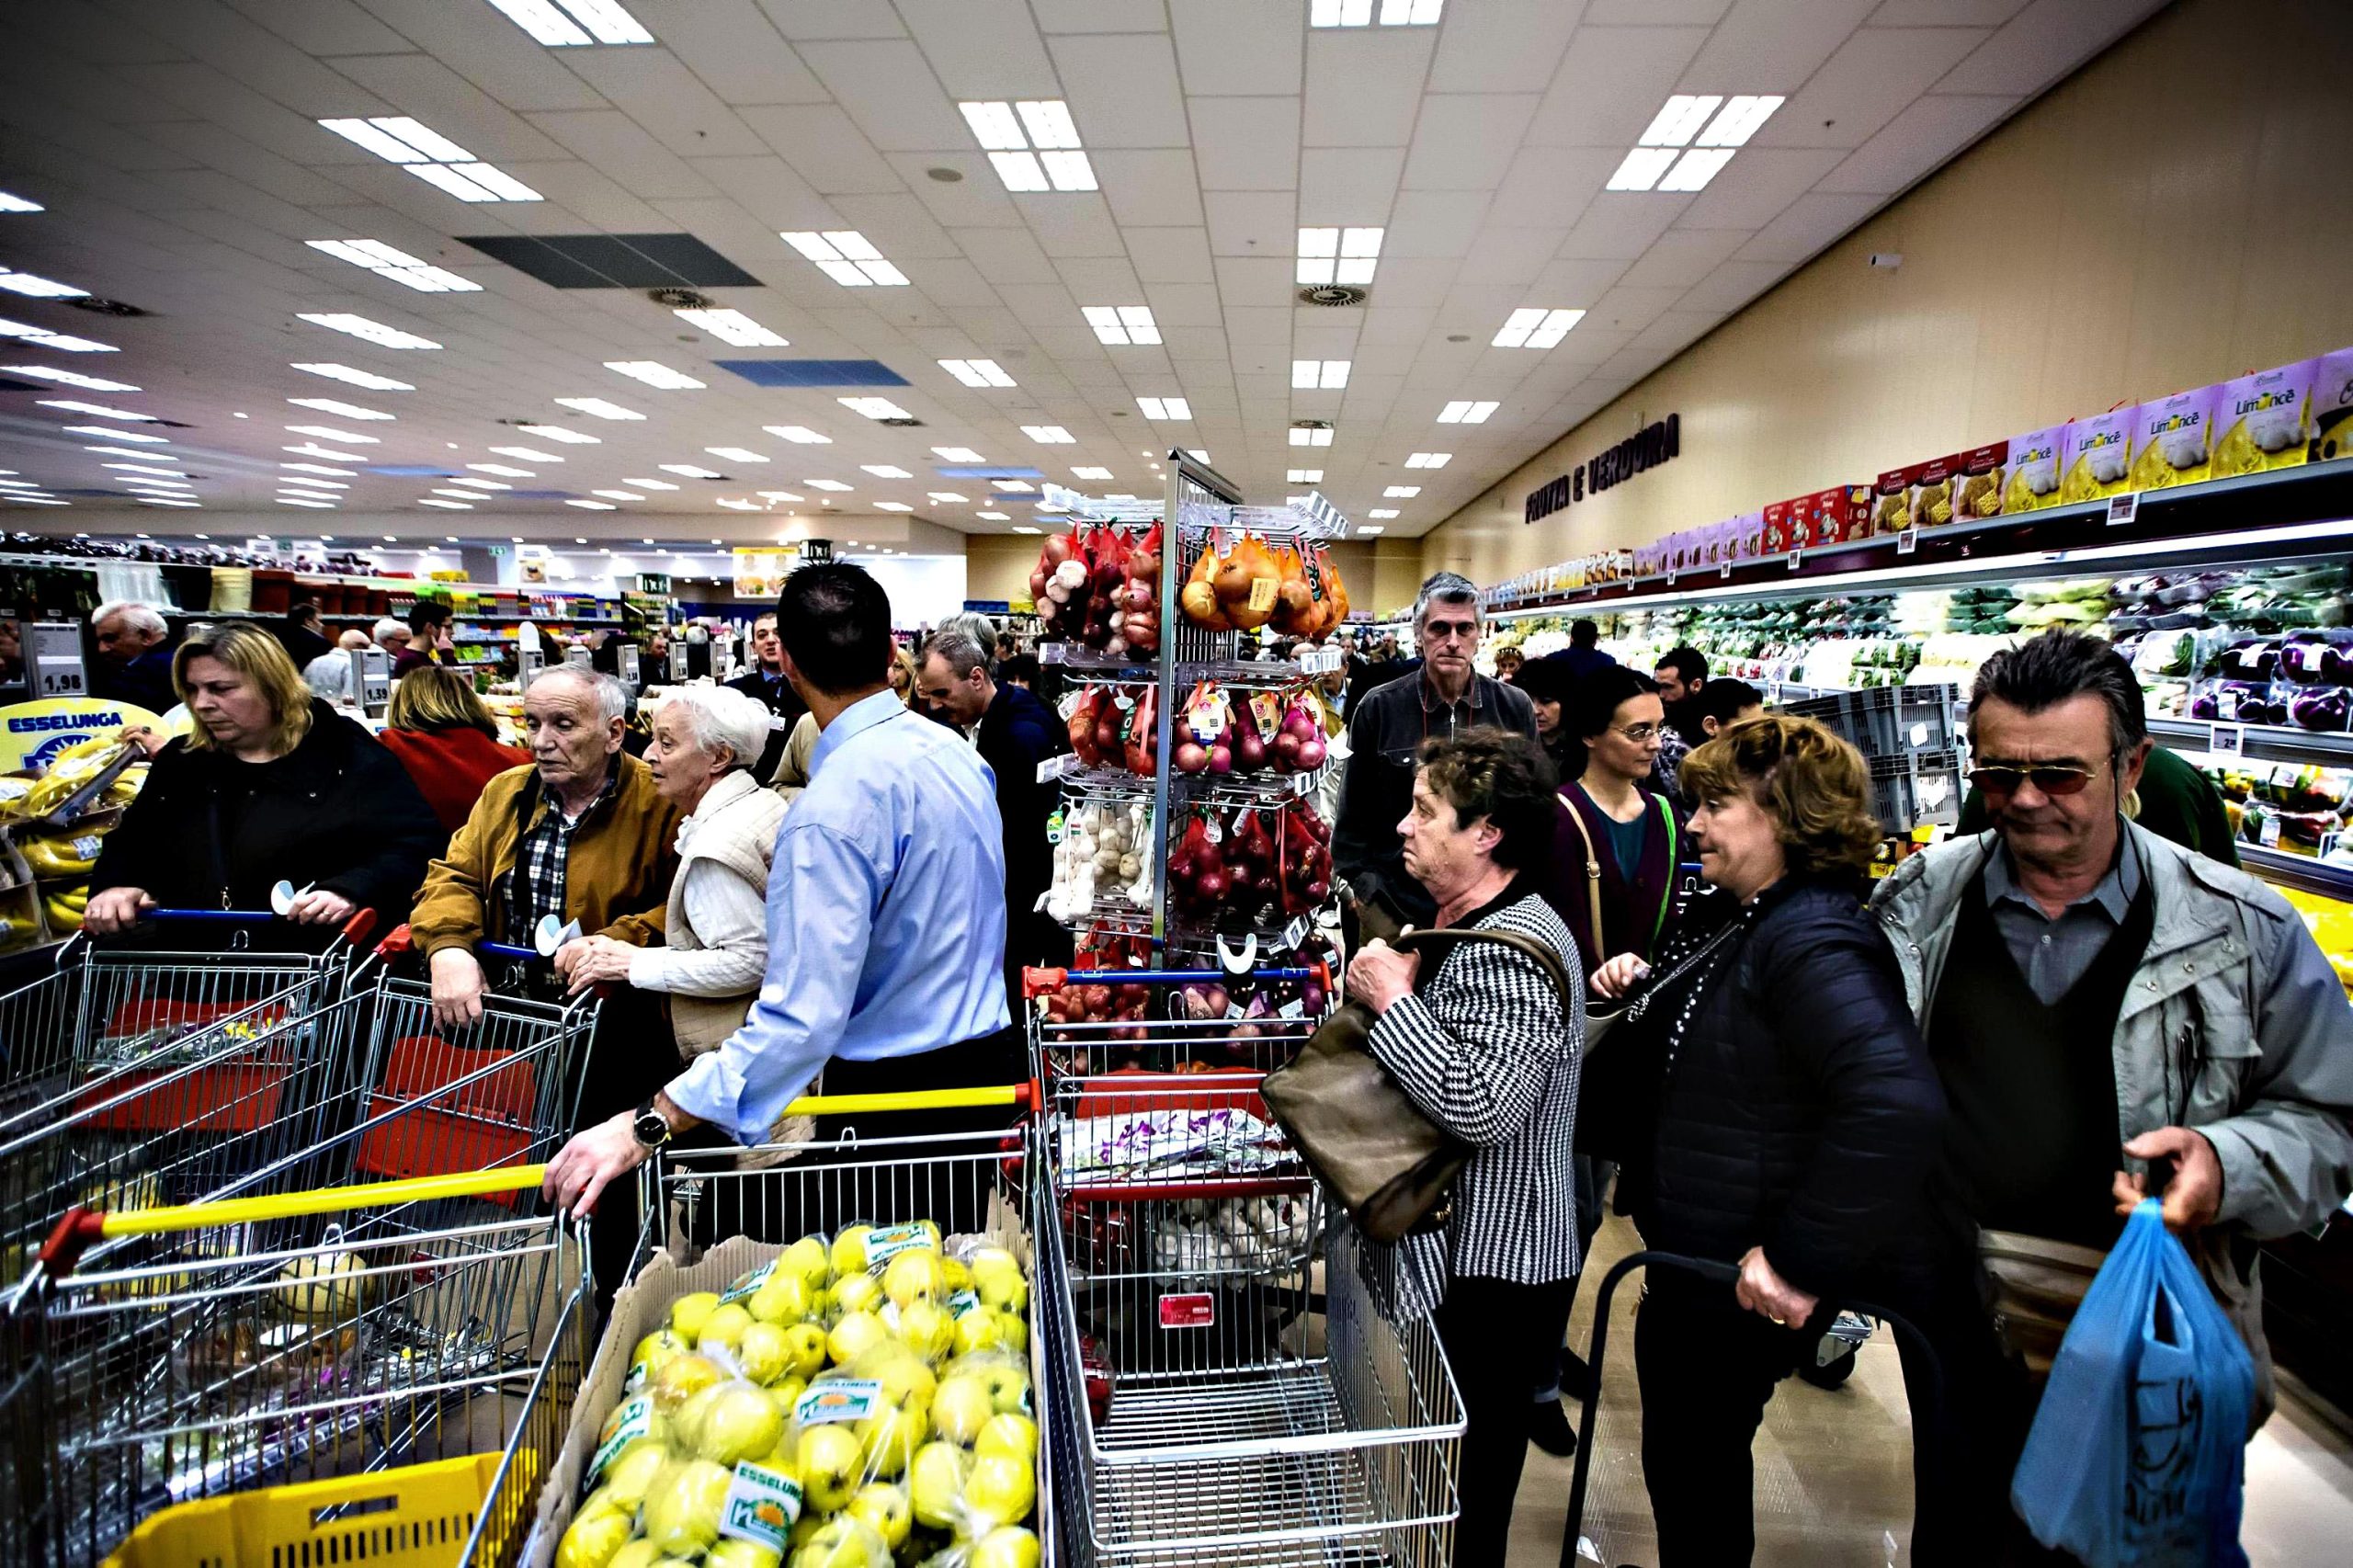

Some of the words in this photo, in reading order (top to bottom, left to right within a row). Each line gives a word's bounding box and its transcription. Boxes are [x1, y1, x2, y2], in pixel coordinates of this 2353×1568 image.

[1525, 474, 1570, 524] FRUTTA
[1573, 465, 1586, 502] E
[1588, 413, 1679, 494] VERDURA
[45, 675, 81, 692] 1,98
[368, 688, 388, 701] 1,39
[7, 712, 123, 733] ESSELUNGA
